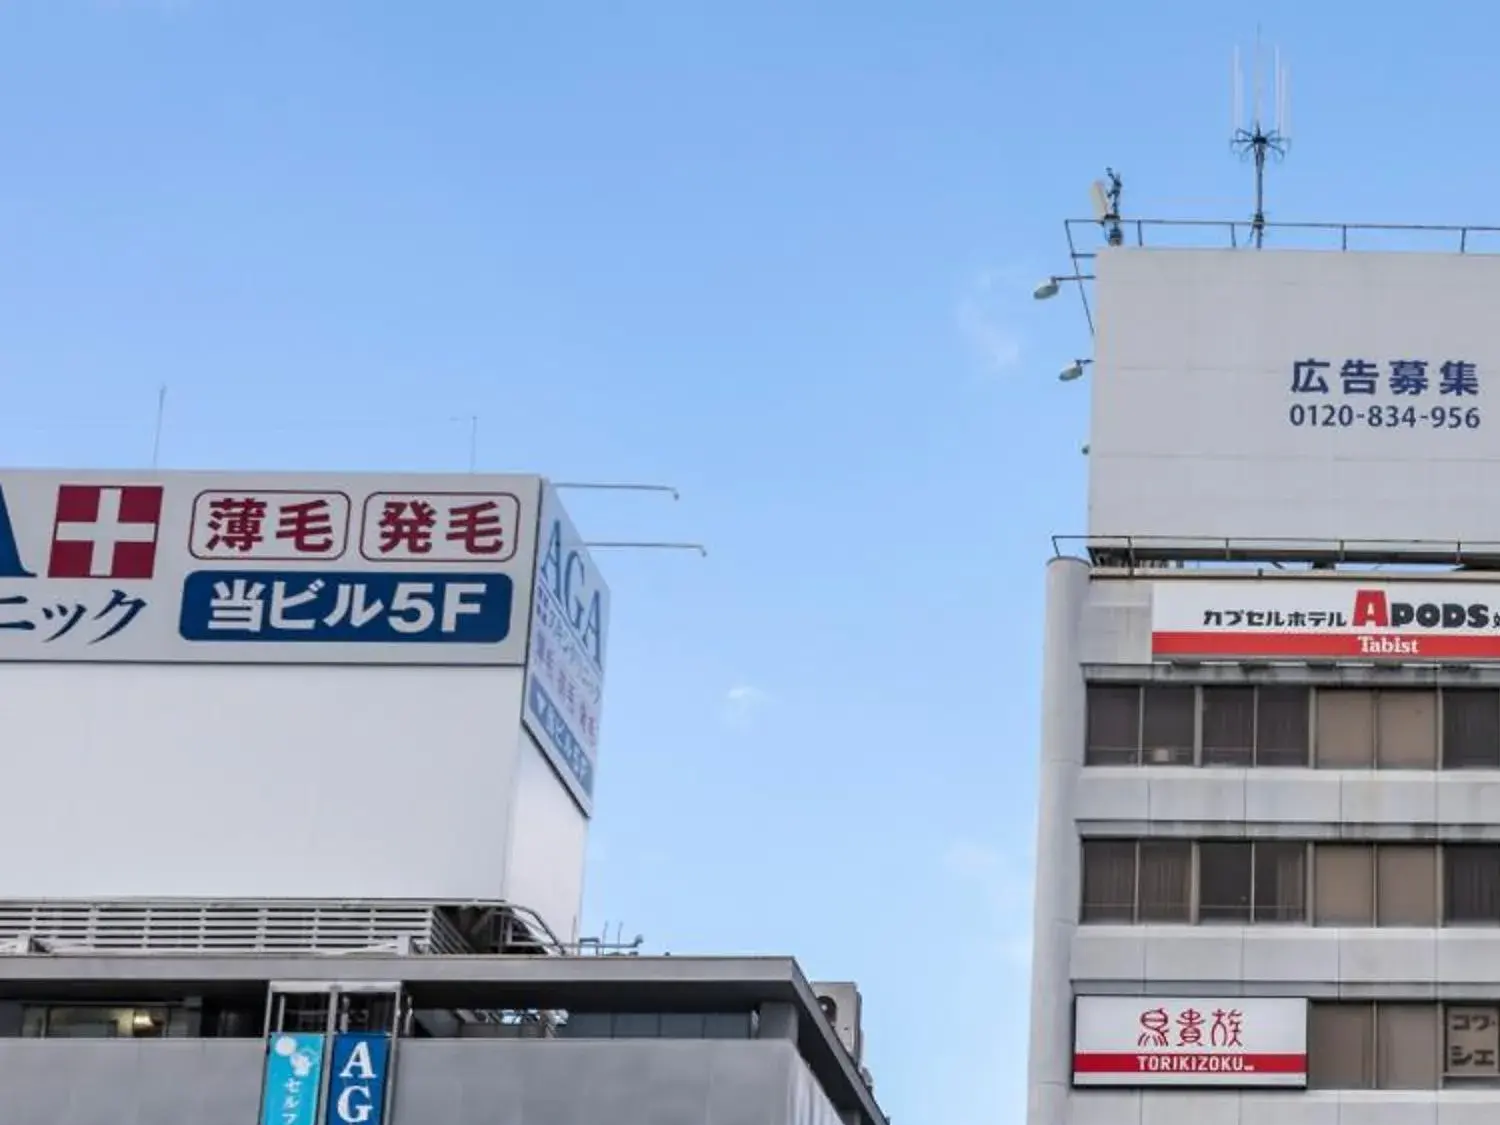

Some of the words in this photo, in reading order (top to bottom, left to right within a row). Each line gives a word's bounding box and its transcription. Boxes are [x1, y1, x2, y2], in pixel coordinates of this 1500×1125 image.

[1291, 358, 1479, 396] 広告募集
[1289, 404, 1481, 429] 0120-834-956
[205, 498, 333, 553] 薄毛
[378, 500, 504, 554] 発毛
[207, 578, 487, 633] 当ビル5F
[1204, 609, 1347, 627] カプセルホテル
[1352, 590, 1489, 629] APODS
[1358, 636, 1419, 654] Tabist
[1138, 1056, 1244, 1071] TORIKIZOKU
